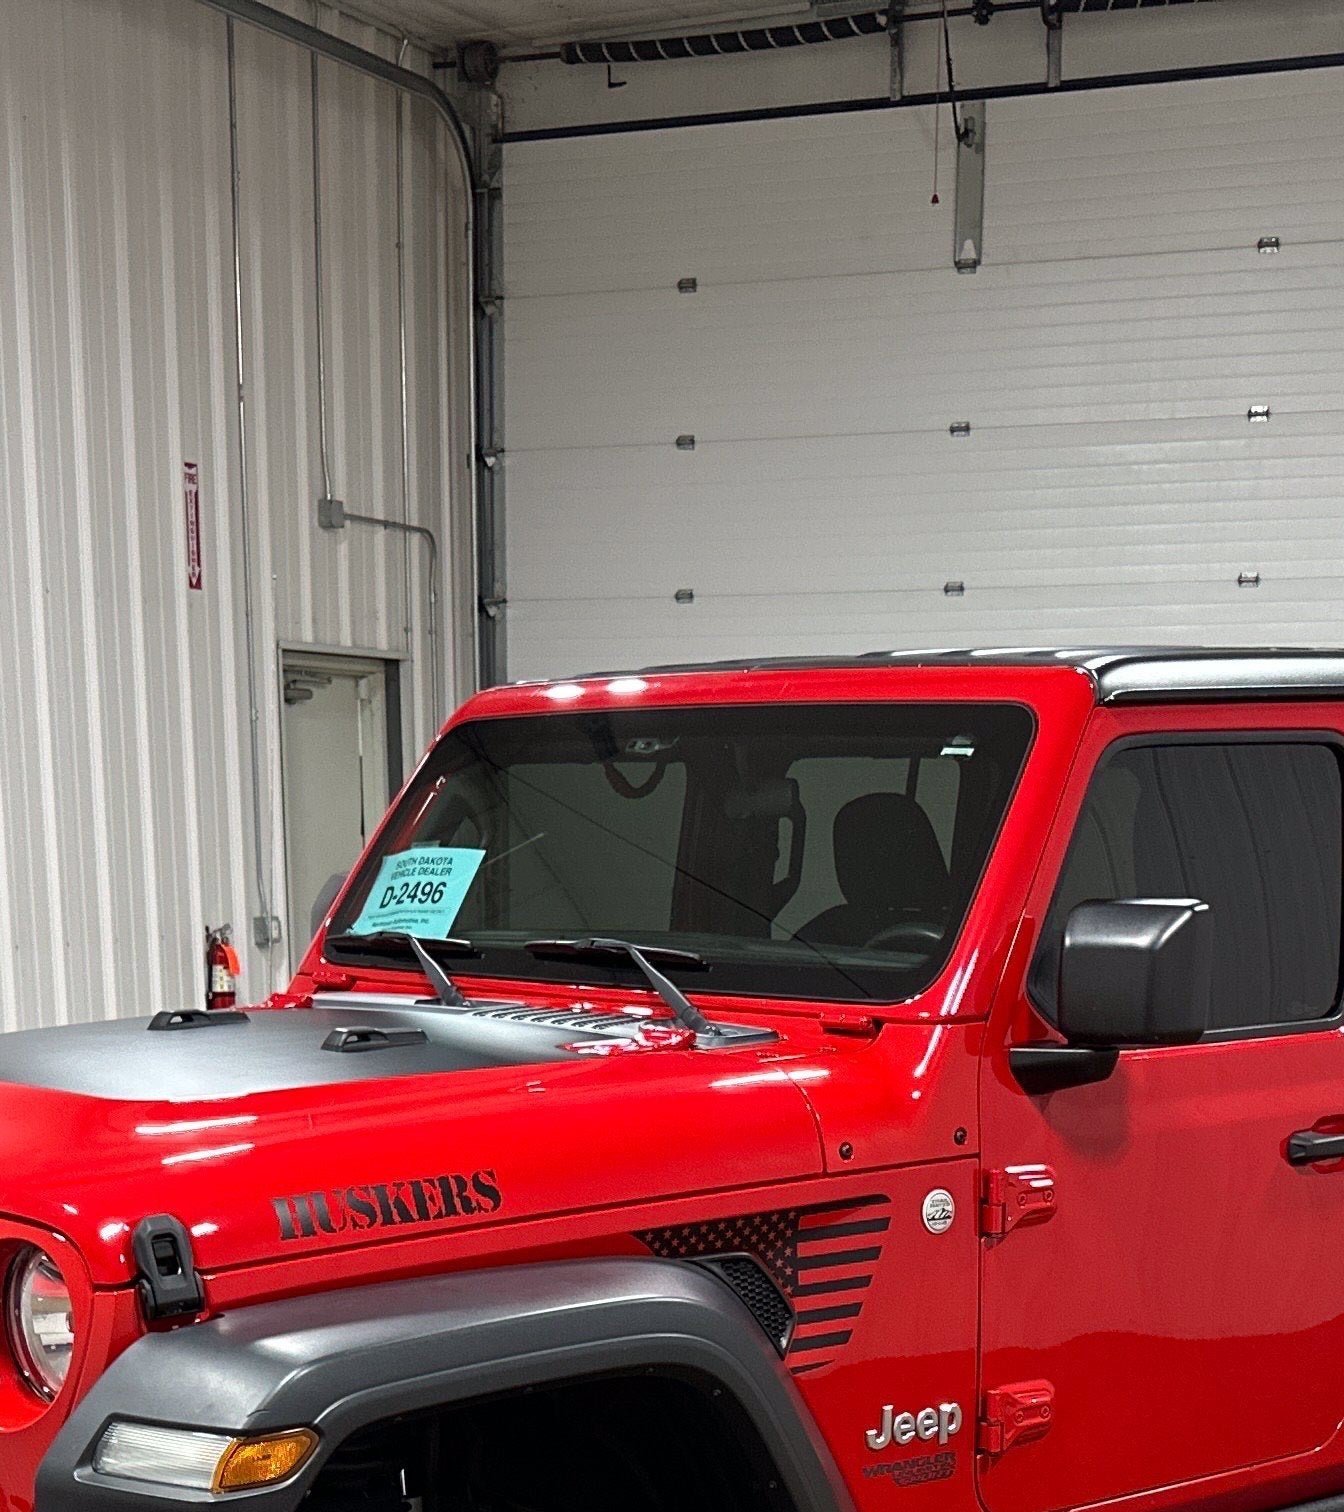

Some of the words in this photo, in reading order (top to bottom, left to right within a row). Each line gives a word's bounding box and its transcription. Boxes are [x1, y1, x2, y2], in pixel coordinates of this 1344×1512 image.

[391, 868, 417, 880] VEHICLE
[417, 867, 453, 876] DEALER
[396, 858, 418, 869] SOUTH
[418, 857, 453, 866] DAKOTA
[379, 881, 447, 909] D-2496
[272, 1169, 502, 1241] HUSKERS
[865, 1402, 963, 1450] Jeep
[863, 1452, 955, 1478] WRANGLER
